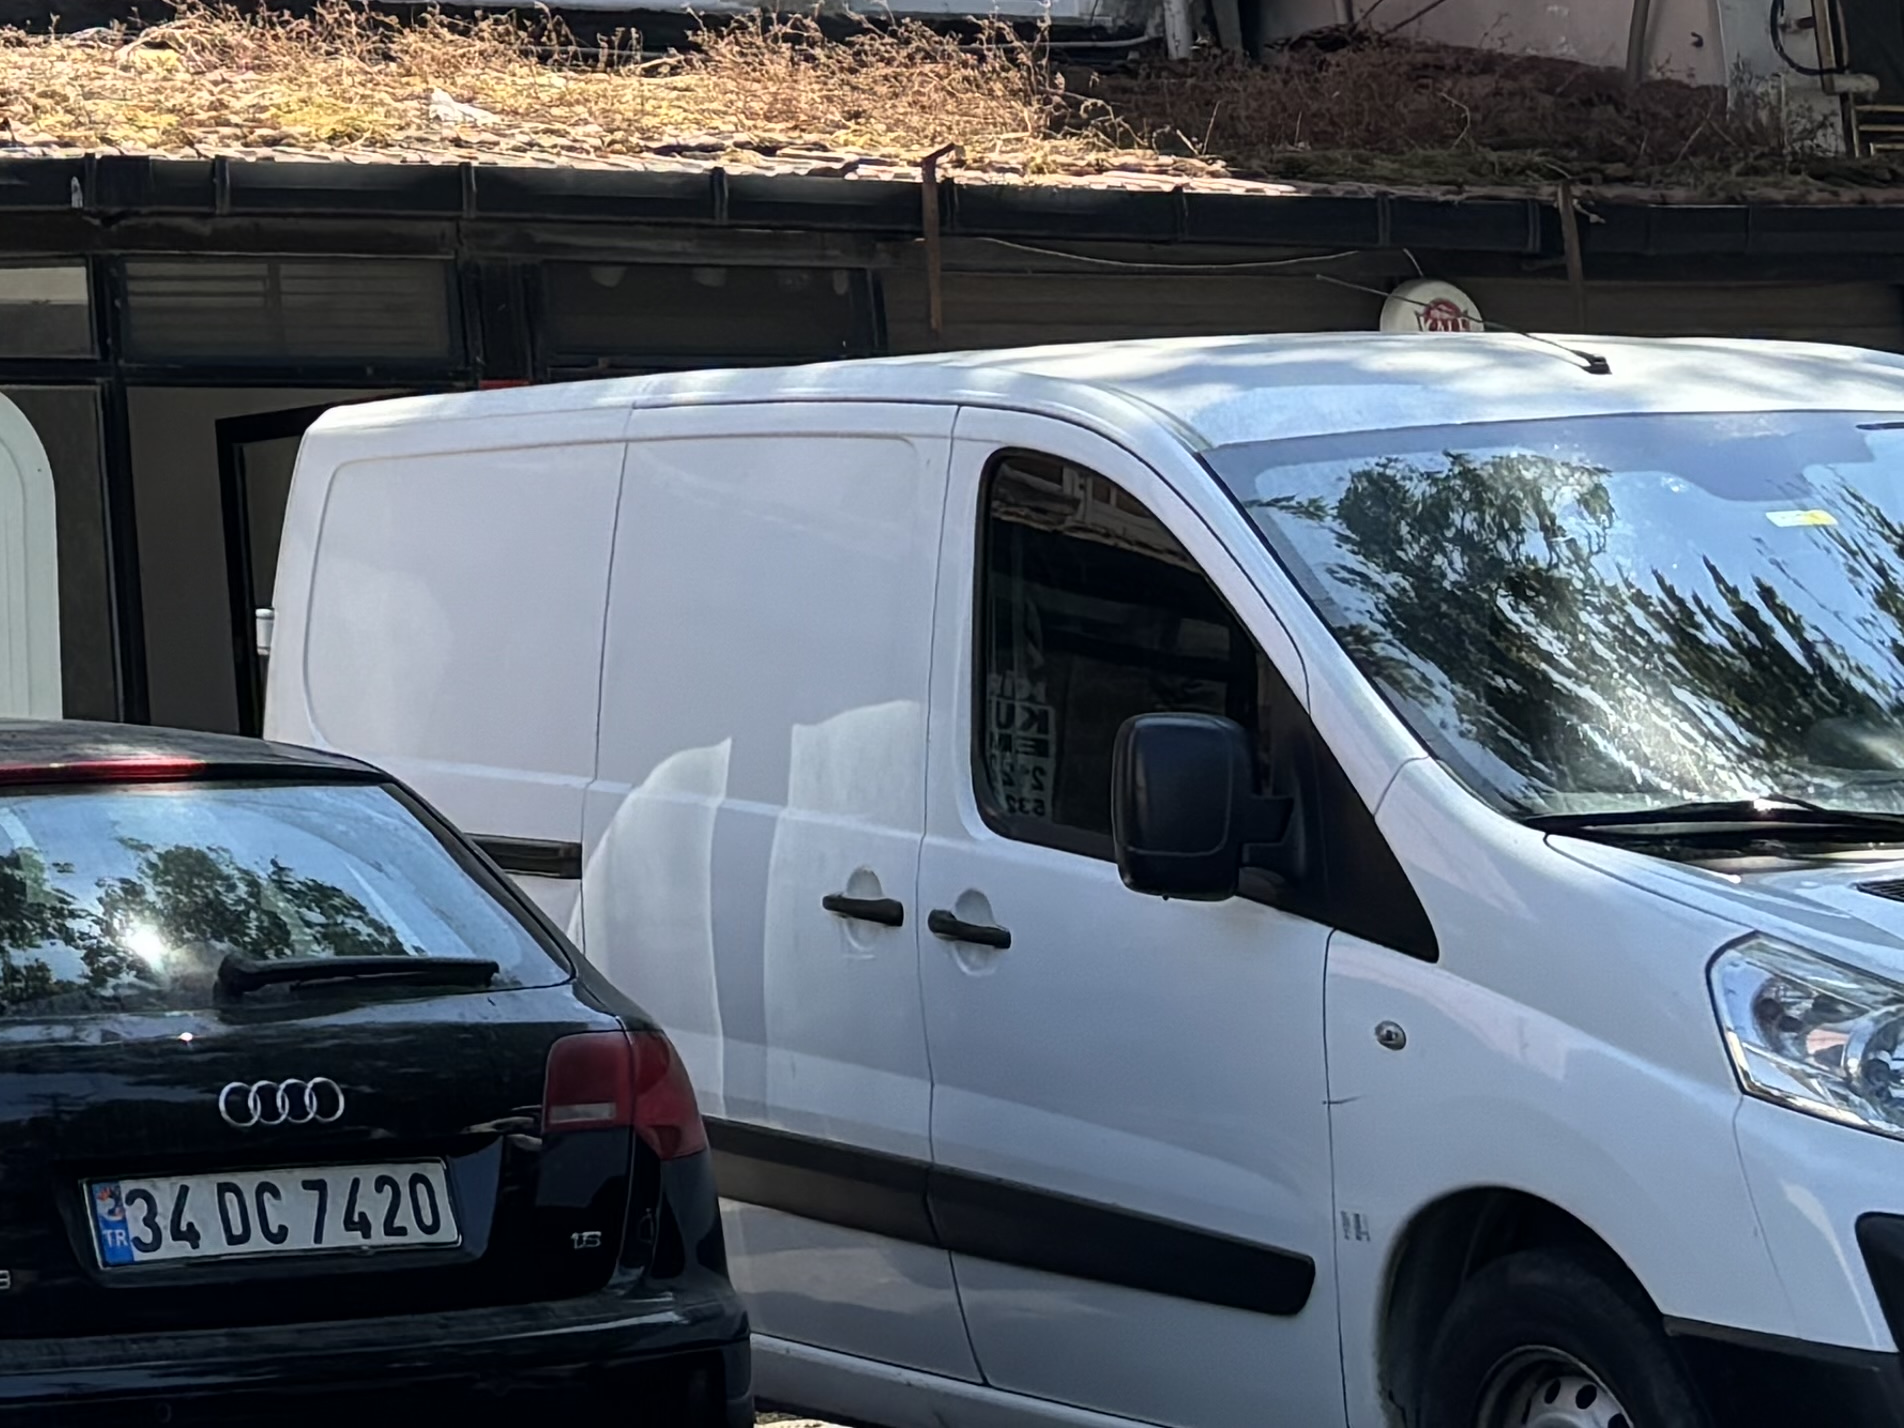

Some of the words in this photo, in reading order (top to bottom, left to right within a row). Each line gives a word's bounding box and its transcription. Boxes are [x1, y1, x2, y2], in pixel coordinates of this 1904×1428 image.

[103, 1228, 129, 1248] TR
[125, 1184, 200, 1253] 34
[216, 1180, 289, 1246] DC
[301, 1172, 441, 1245] 7420
